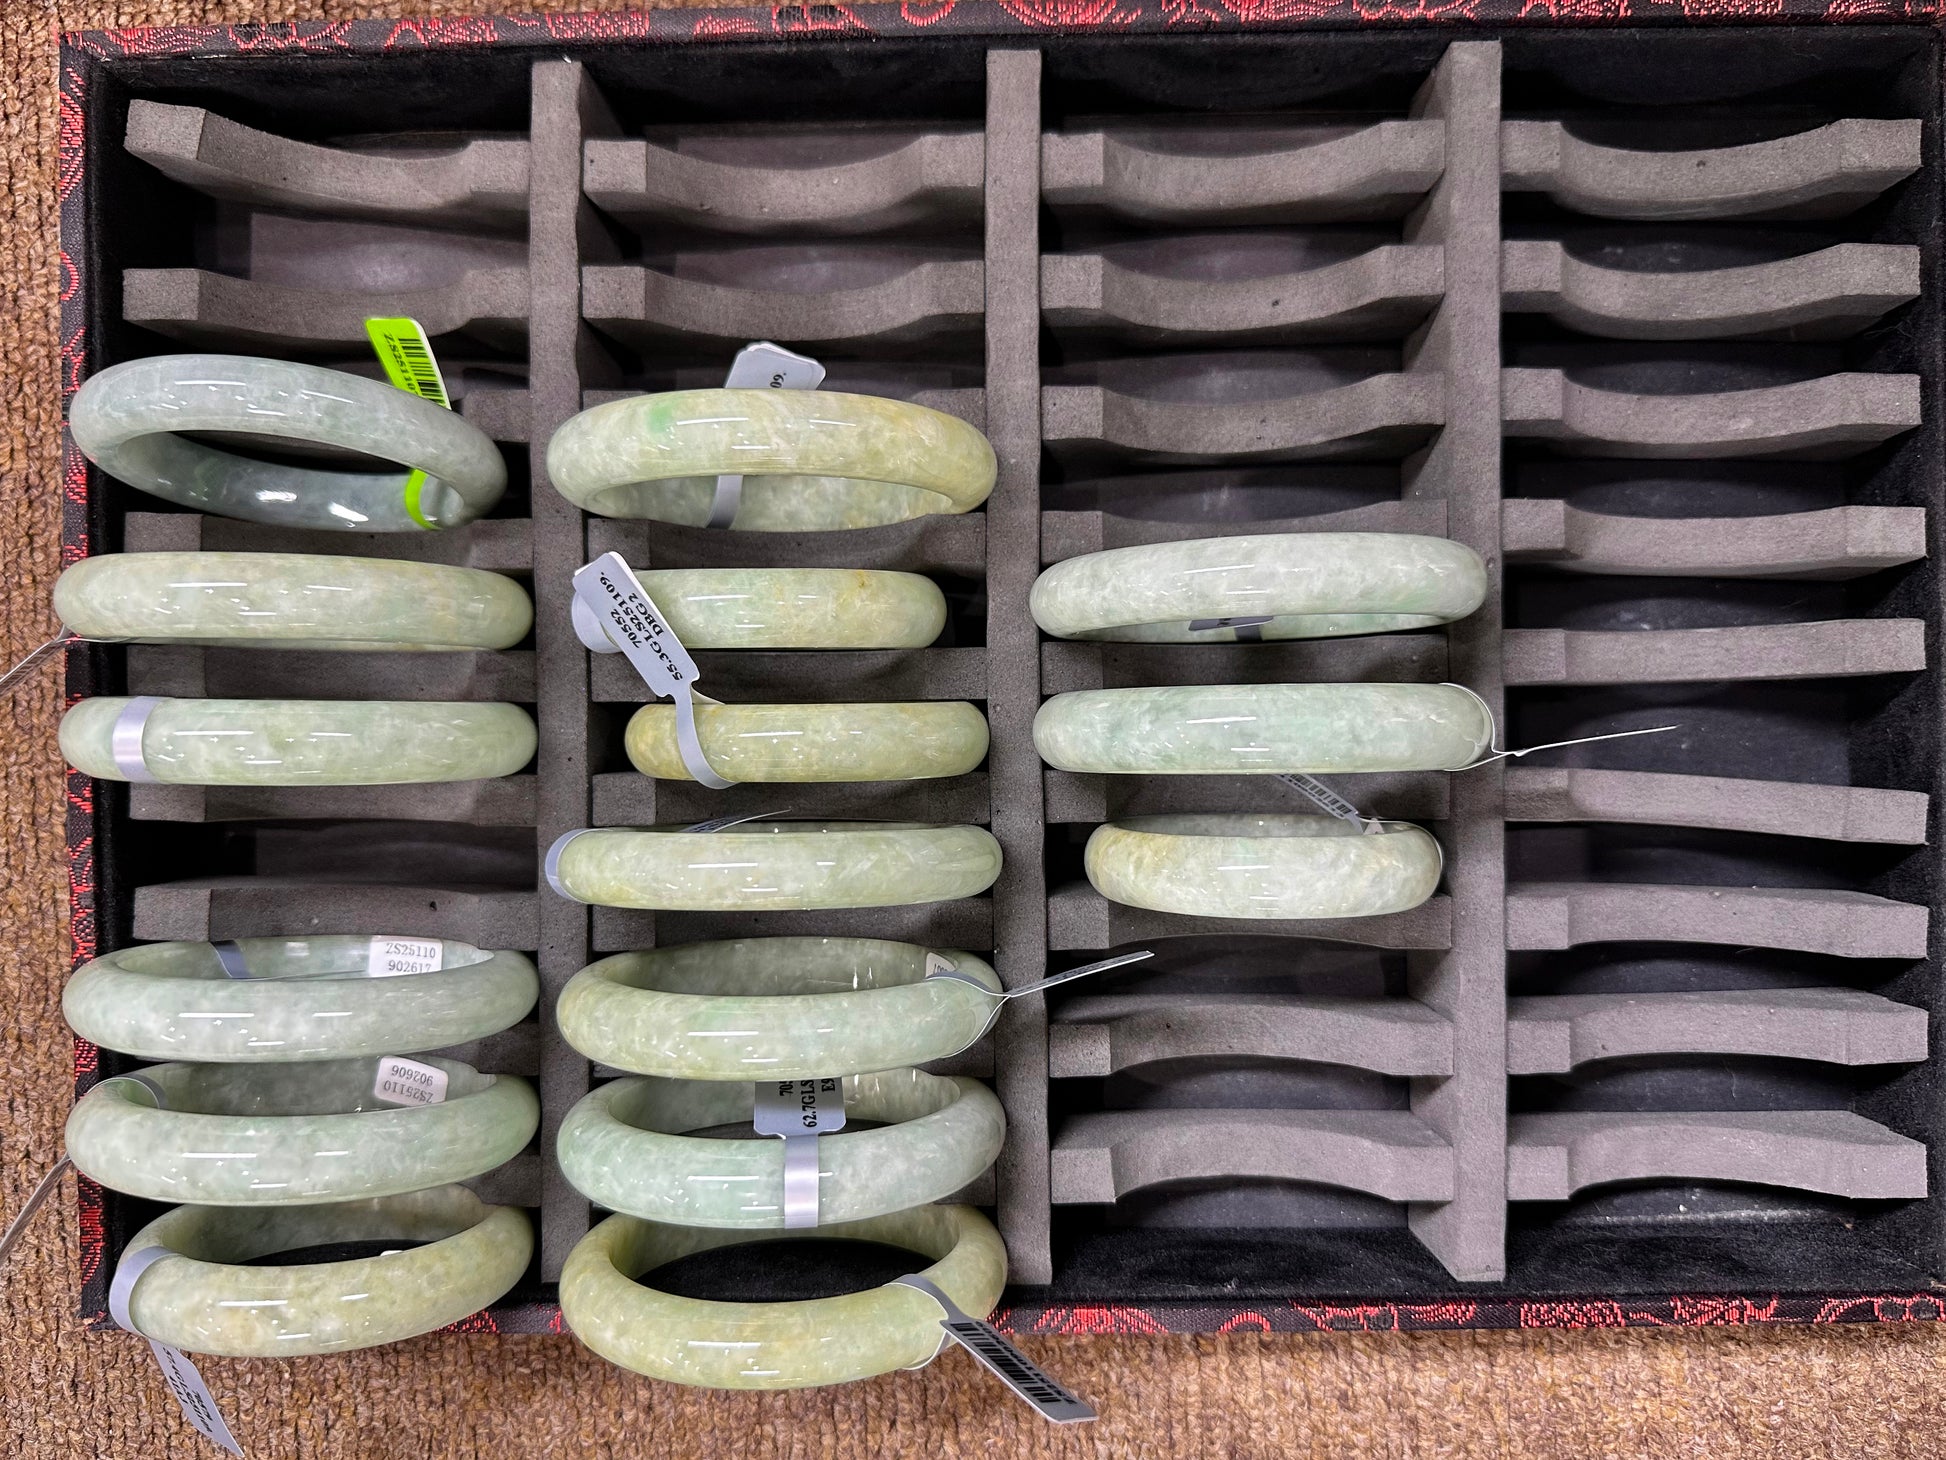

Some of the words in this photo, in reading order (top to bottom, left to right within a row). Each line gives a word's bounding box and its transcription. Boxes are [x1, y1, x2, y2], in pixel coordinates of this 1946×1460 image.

[610, 608, 642, 648] 70552
[386, 942, 436, 958] ZS25110
[388, 959, 431, 973] 902617
[391, 1065, 434, 1086] 902606
[383, 1080, 434, 1103] ZS25110
